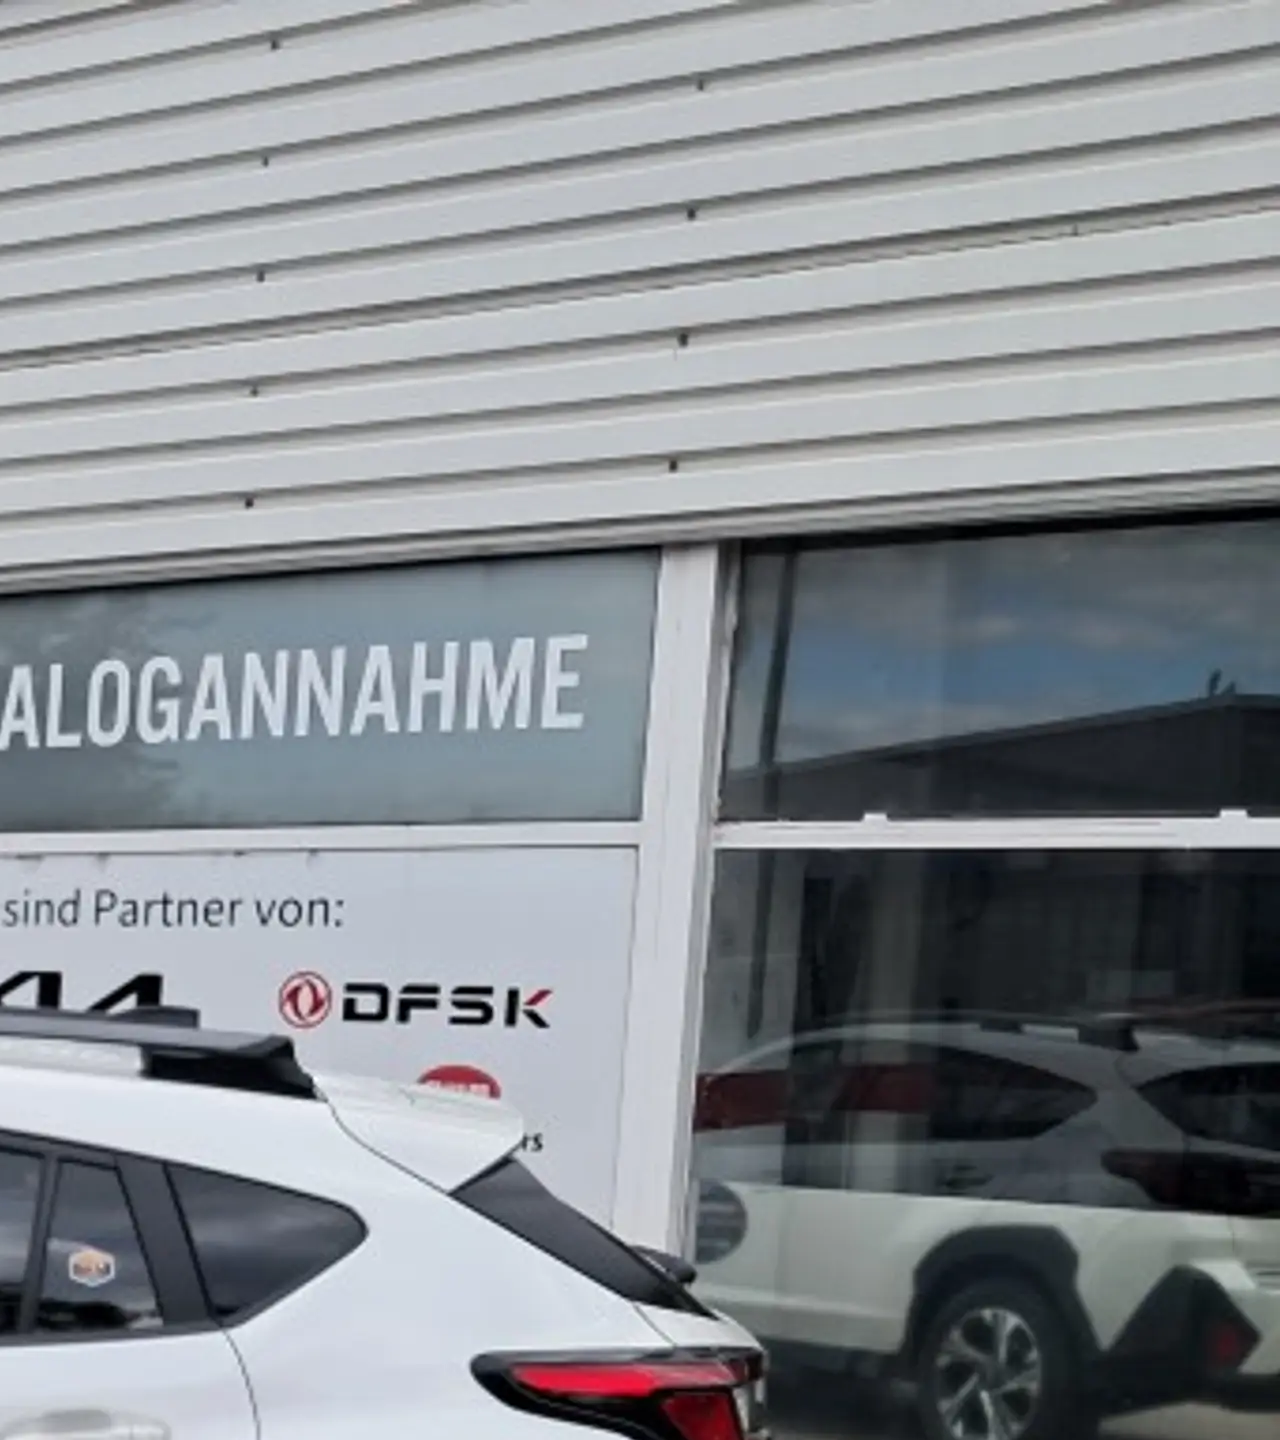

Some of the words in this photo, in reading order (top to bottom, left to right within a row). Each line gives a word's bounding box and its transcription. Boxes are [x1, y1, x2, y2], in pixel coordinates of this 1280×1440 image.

[2, 889, 80, 926] sind
[95, 890, 244, 927] Partner
[254, 899, 346, 928] von:
[341, 983, 554, 1029] DFSK
